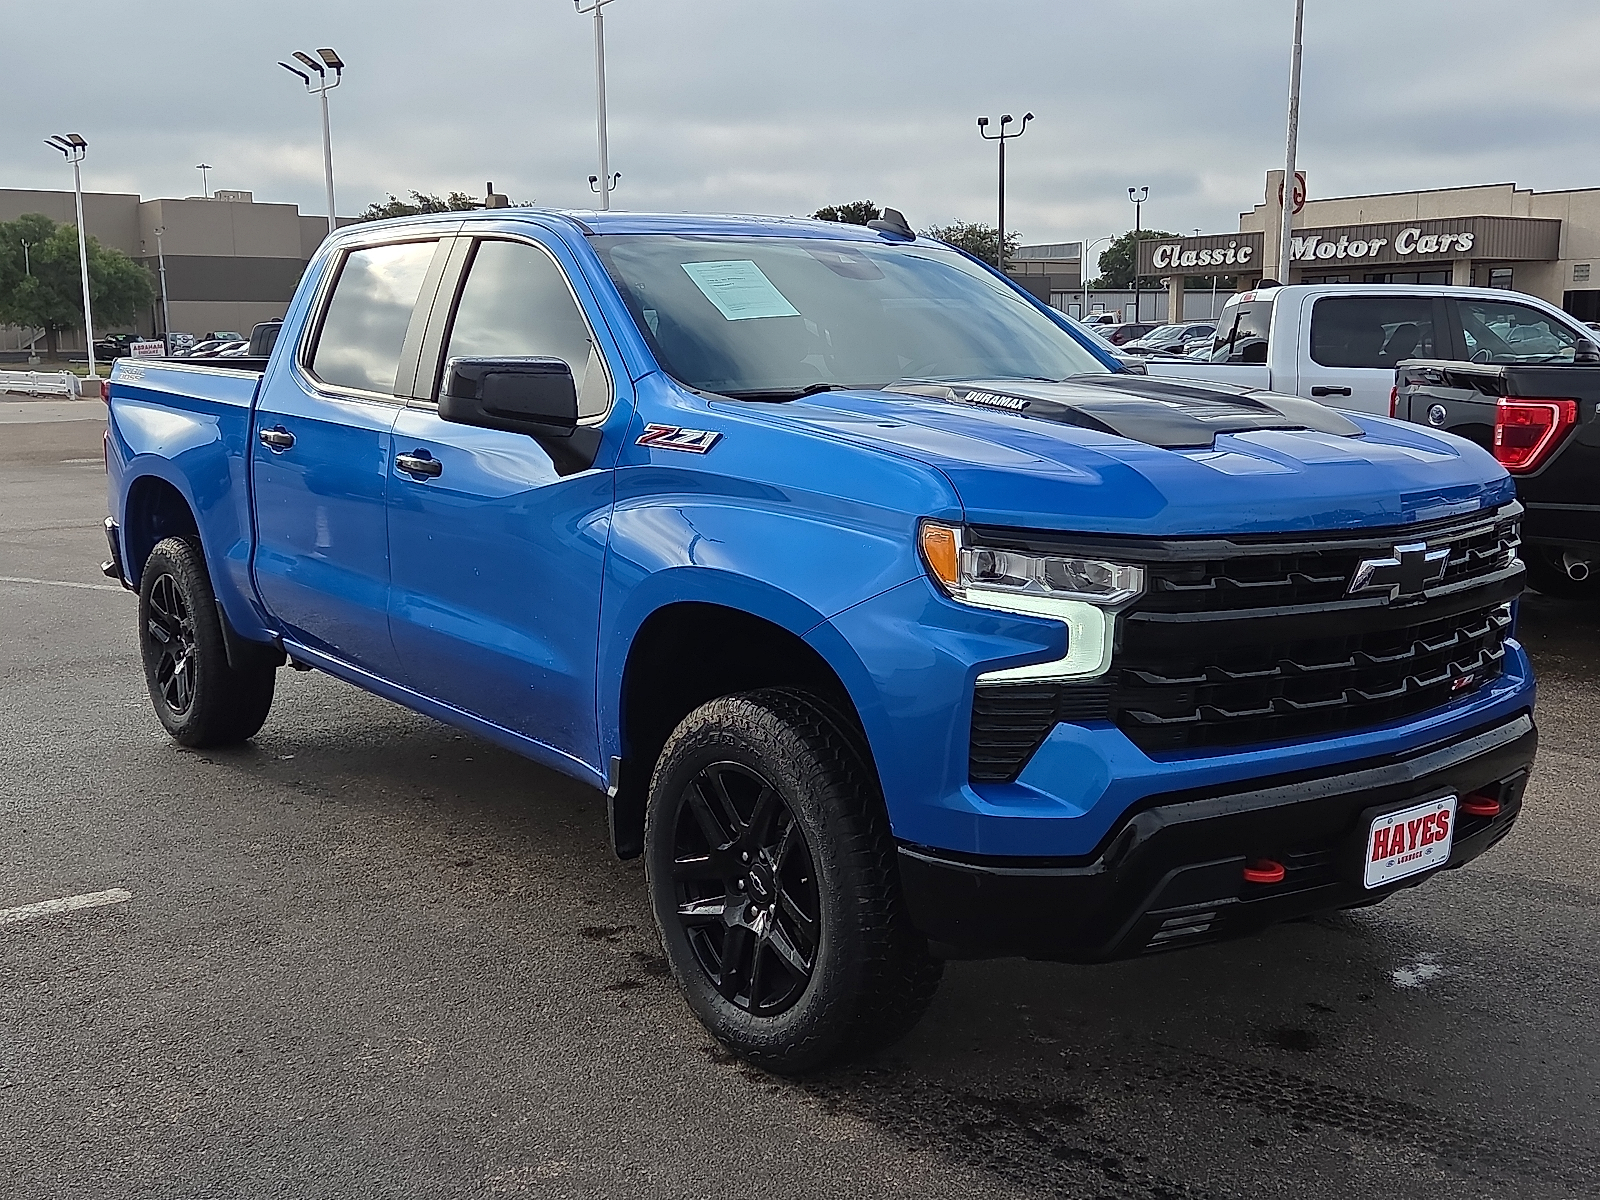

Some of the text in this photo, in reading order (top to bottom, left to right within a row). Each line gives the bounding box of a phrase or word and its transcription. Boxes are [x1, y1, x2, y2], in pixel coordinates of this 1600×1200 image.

[1153, 228, 1475, 268] Classic Motor Cars
[964, 390, 1028, 411] DURAMAX
[634, 422, 722, 454] Z71
[1371, 809, 1451, 862] HAYES
